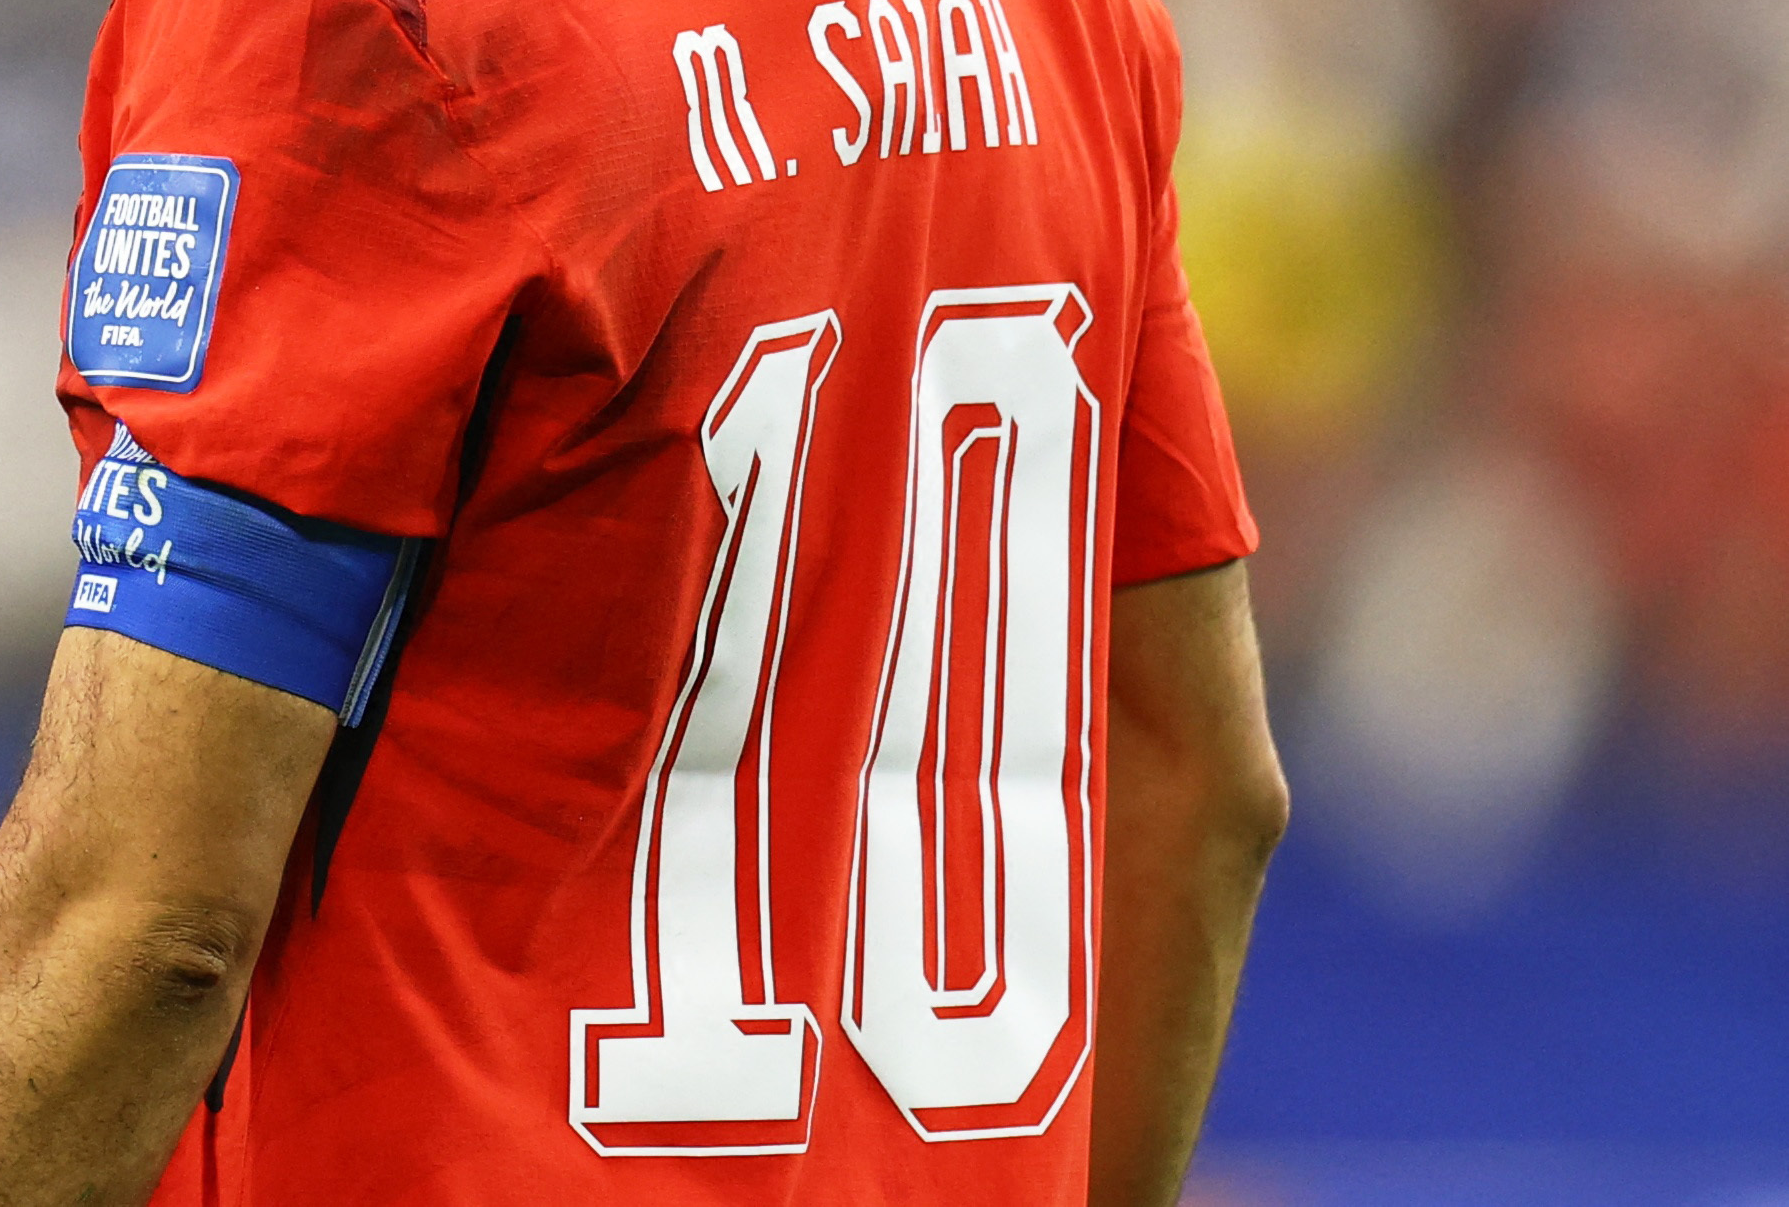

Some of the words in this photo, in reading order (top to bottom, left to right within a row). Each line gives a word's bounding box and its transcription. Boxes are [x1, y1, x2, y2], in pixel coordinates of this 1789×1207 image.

[672, 23, 798, 193] M.
[102, 193, 199, 232] FOOTBALL
[93, 228, 196, 279] UNITES
[83, 277, 115, 319] the
[114, 280, 195, 328] World
[100, 325, 141, 347] FIFA
[77, 459, 168, 526] ITES
[77, 519, 172, 585] World
[79, 581, 109, 606] FIFA
[570, 282, 1100, 1157] 10
